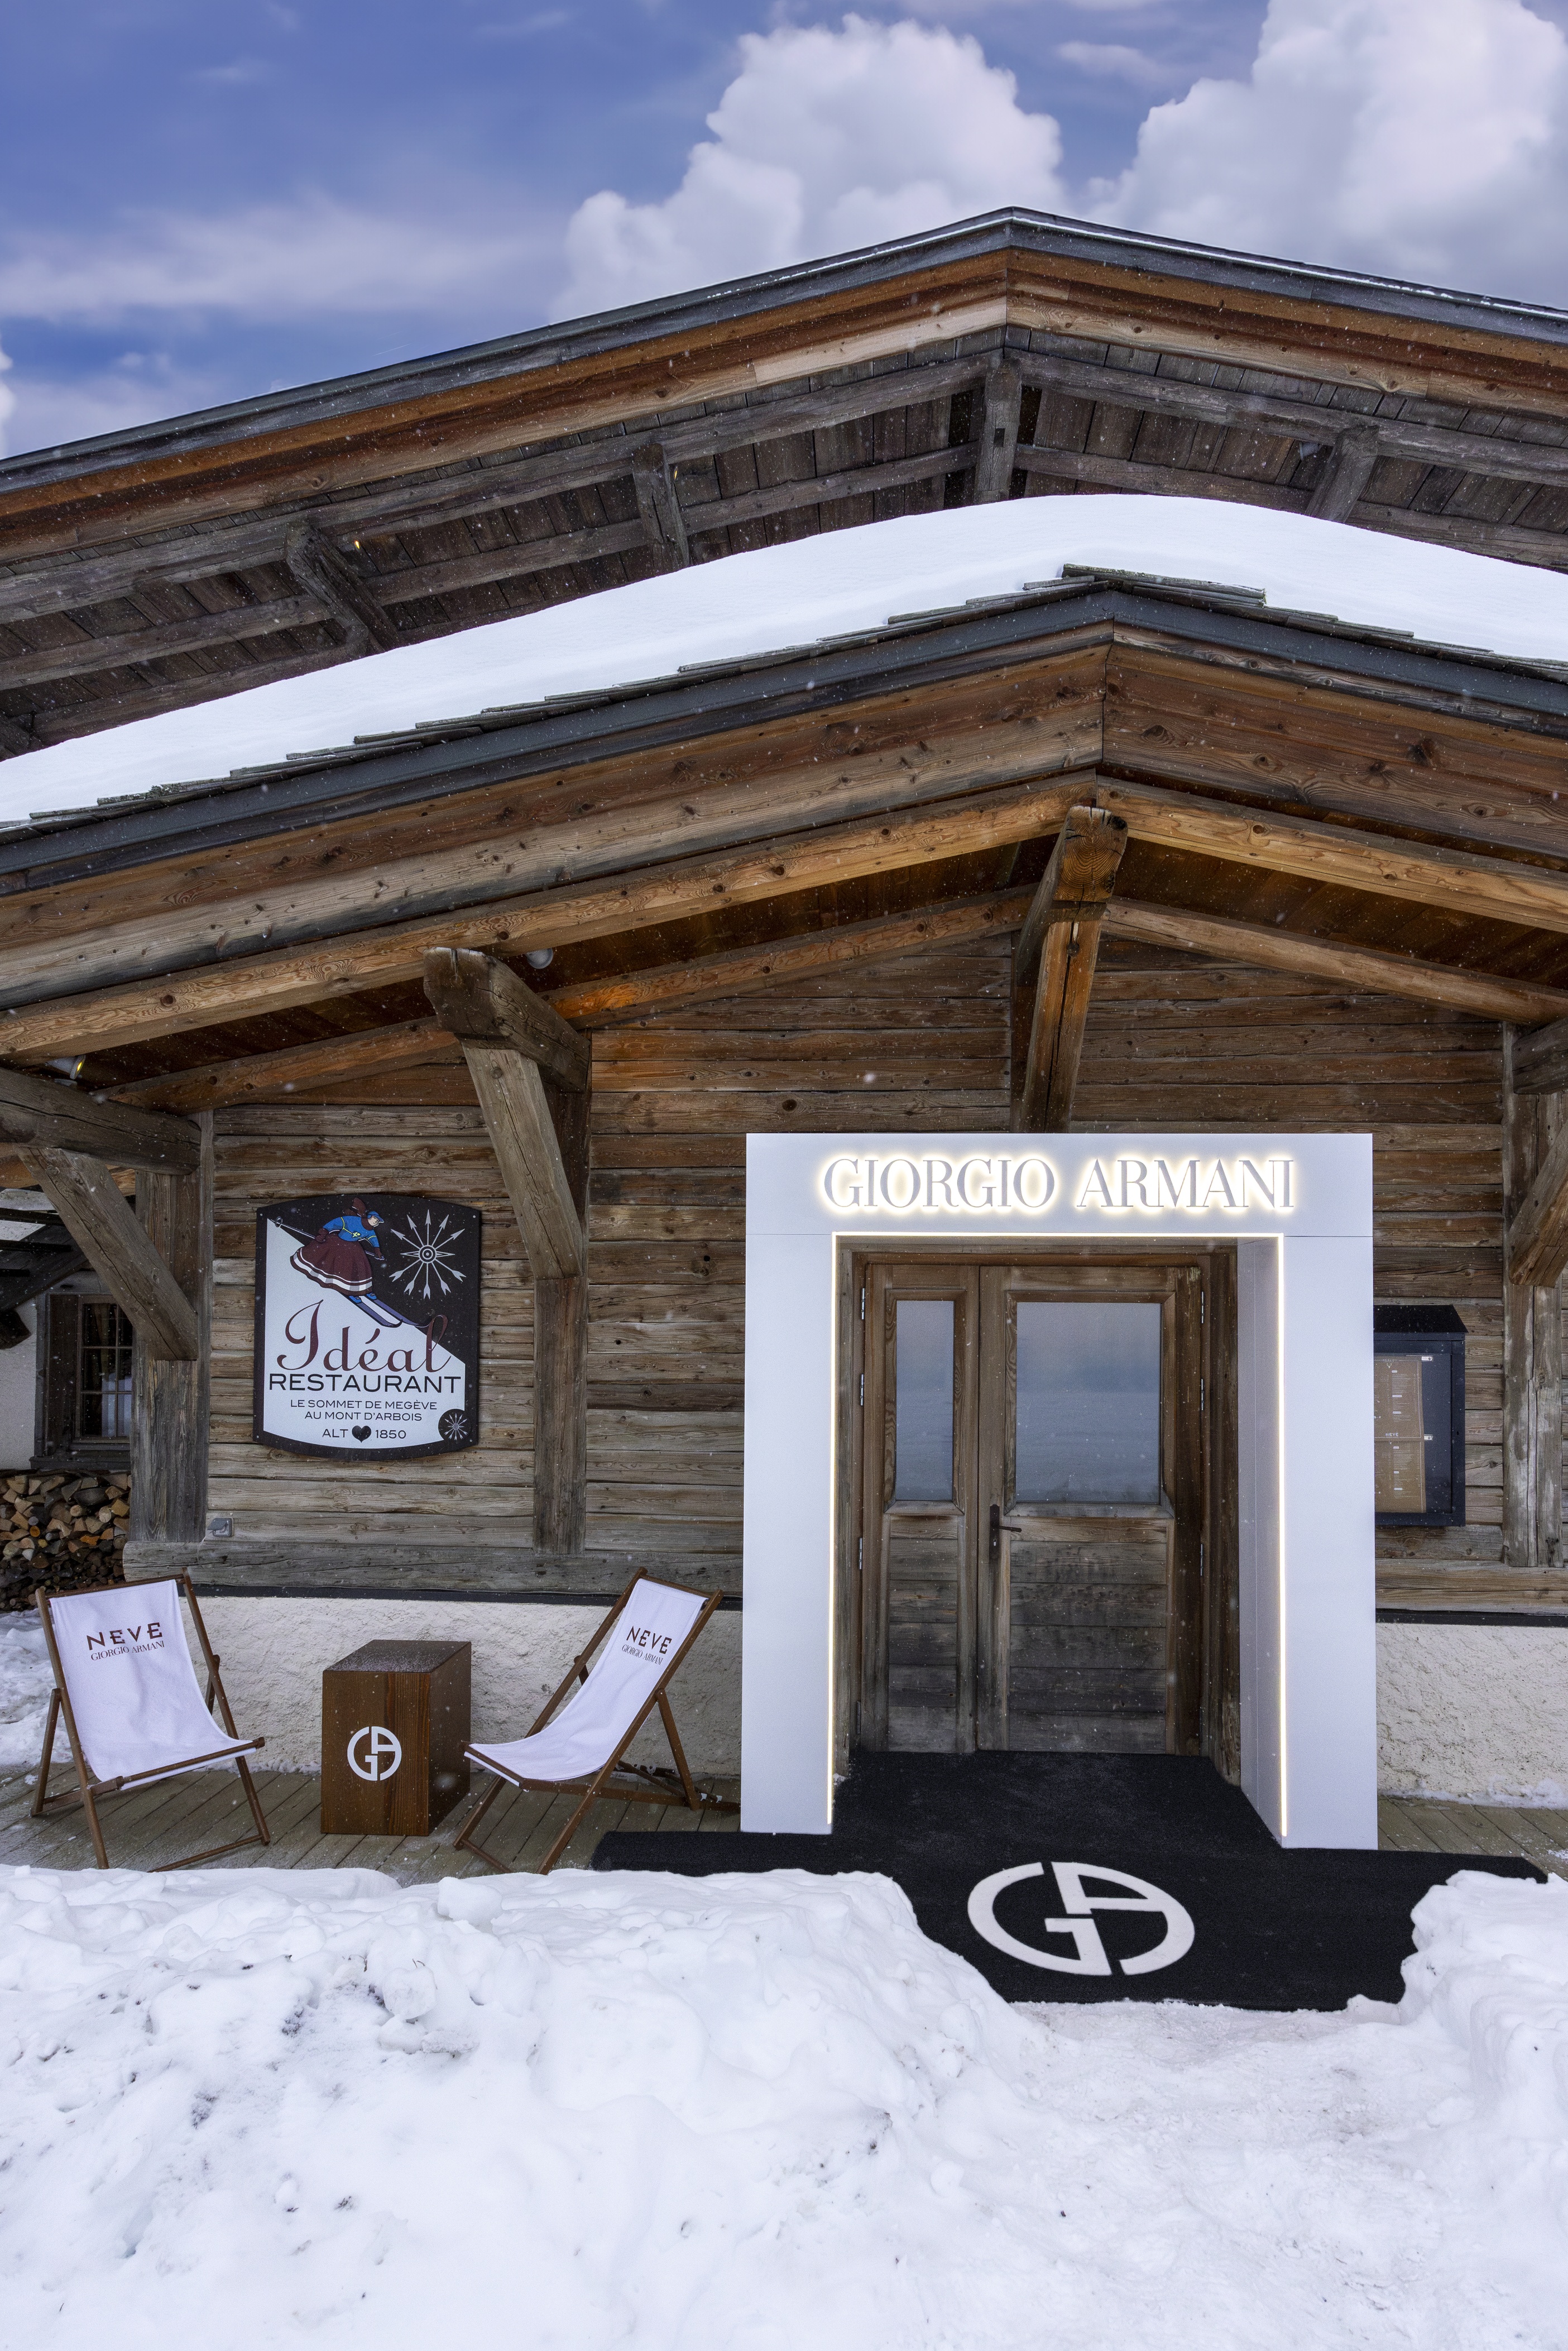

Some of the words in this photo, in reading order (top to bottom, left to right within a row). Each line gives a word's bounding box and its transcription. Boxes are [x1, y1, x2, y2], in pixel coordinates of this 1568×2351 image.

[824, 1158, 1056, 1209] GIORGIO
[1076, 1158, 1295, 1209] ARMANI
[276, 1299, 452, 1372] Idéal
[269, 1373, 462, 1394] RESTAURANT
[290, 1399, 305, 1407] LE
[308, 1400, 362, 1409] SOMMET
[365, 1400, 381, 1409] DE
[385, 1400, 437, 1410] MEGÈVE
[305, 1411, 323, 1419] AU
[325, 1411, 362, 1420] MONT
[322, 1429, 348, 1438] ALT
[376, 1429, 406, 1439] 1850
[87, 1622, 162, 1650] NEVE
[626, 1625, 672, 1654] NEVE
[91, 1646, 130, 1661] GIORGIO
[131, 1640, 165, 1654] ARMANI
[622, 1644, 643, 1658] GIORGIO
[643, 1653, 663, 1665] ARMANI
